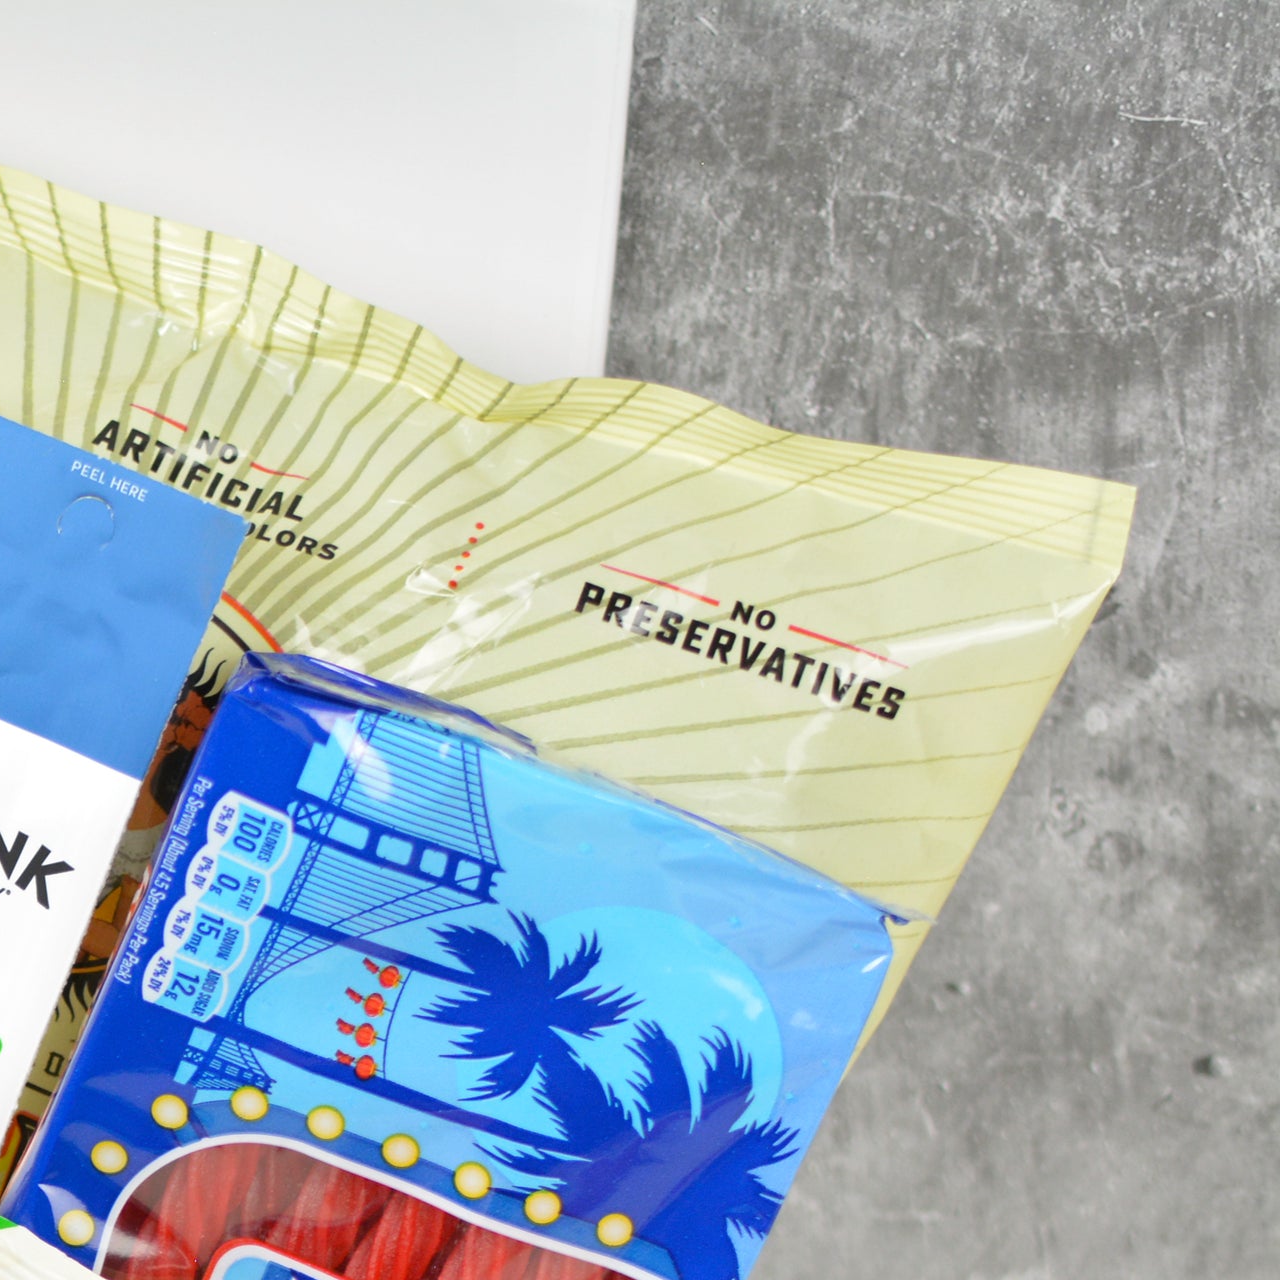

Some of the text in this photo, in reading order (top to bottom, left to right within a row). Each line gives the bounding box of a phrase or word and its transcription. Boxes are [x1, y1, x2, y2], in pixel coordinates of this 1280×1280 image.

[195, 430, 239, 465] NO
[71, 460, 149, 502] PEEL HERE
[91, 419, 304, 522] ARTIFICIAL
[728, 599, 777, 632] NO
[575, 581, 908, 721] PRESERVATIVES
[190, 775, 214, 798] Per
[172, 795, 206, 836] Serving
[232, 812, 268, 854] 100
[256, 820, 284, 865] CALORIES
[214, 926, 240, 961] SODIUM
